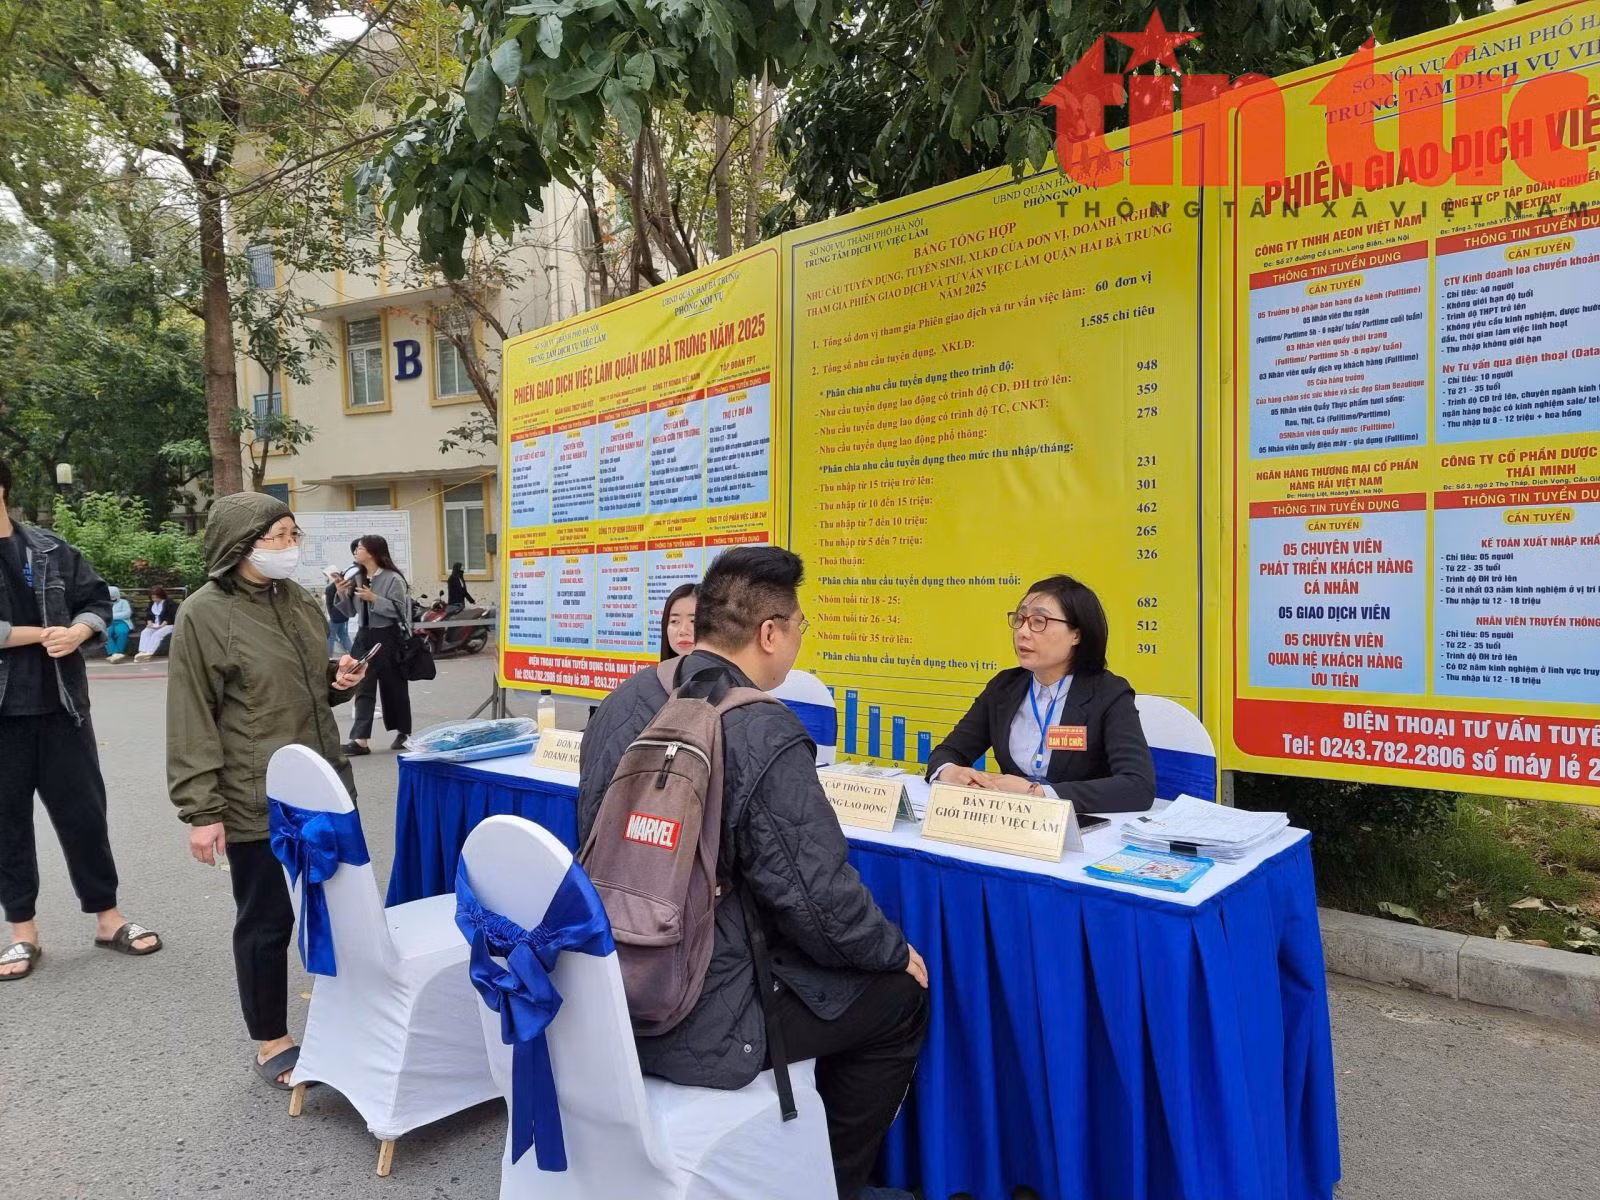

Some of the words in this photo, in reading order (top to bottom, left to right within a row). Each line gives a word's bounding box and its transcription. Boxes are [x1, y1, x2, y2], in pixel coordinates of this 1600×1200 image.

[1325, 92, 1399, 125] TRUNG
[1404, 78, 1452, 105] TÂM
[1459, 62, 1519, 92] DỊCH
[1525, 52, 1559, 75] VỤ
[1264, 160, 1353, 215] PHIÊN
[1365, 142, 1440, 192] GIAO
[1451, 120, 1534, 177] DỊCH
[914, 239, 946, 258] BẢNG
[950, 229, 985, 248] TỔNG
[989, 221, 1016, 238] HỢP
[1254, 242, 1283, 257] CÔNG
[1285, 239, 1298, 251] TY
[1302, 233, 1329, 248] TNHH
[1332, 226, 1363, 242] AEON
[1366, 220, 1391, 235] VIỆT
[1394, 214, 1422, 230] NAM
[1273, 268, 1308, 283] THÔNG
[1310, 264, 1328, 276] TIN
[1331, 256, 1366, 273] TUYỂN
[1369, 251, 1401, 266] DỤNG
[1095, 279, 1109, 292] 60
[1115, 274, 1137, 287] đơn
[1141, 269, 1152, 282] vị
[1309, 282, 1328, 295] CẦN
[1331, 277, 1361, 291] TUYỂN
[939, 287, 962, 300] NĂM
[965, 282, 986, 295] 2025
[1081, 312, 1109, 327] 1.585
[1113, 308, 1130, 322] chỉ
[1133, 305, 1155, 318] tiêu
[393, 339, 423, 381] B
[514, 380, 535, 405] PHIÊN
[537, 376, 554, 399] GIAO
[555, 370, 574, 397] DỊCH
[575, 362, 593, 390] VIỆC
[594, 357, 612, 383] LÀM
[614, 349, 639, 379] QUẬN
[641, 346, 655, 370] HAI
[658, 338, 671, 365] BÀ
[675, 331, 707, 360] TRƯNG
[709, 321, 735, 351] NĂM
[737, 314, 765, 343] 2025
[1136, 359, 1158, 372] 948
[1136, 382, 1158, 395] 359
[1136, 405, 1158, 419] 278
[1136, 455, 1158, 467] 231
[1256, 469, 1281, 481] NGÂN
[1283, 467, 1309, 479] HÀNG
[1311, 465, 1349, 477] THƯƠNG
[1351, 464, 1371, 475] MẠI
[1373, 460, 1387, 472] CỔ
[1390, 458, 1419, 471] PHẦN
[1136, 478, 1158, 490] 301
[1289, 480, 1315, 491] HÀNG
[1317, 478, 1334, 489] HẢI
[1336, 477, 1357, 489] VIỆT
[1359, 477, 1382, 487] NAM
[1136, 501, 1158, 514] 462
[1136, 525, 1158, 537] 265
[1136, 548, 1158, 560] 326
[1283, 543, 1298, 556] 05
[1301, 539, 1350, 555] CHUYÊN
[1353, 539, 1382, 554] VIÊN
[1445, 553, 1458, 561] Chỉ
[1491, 553, 1514, 561] người
[1260, 560, 1290, 576] PHÁT
[1293, 559, 1326, 575] TRIỂN
[1330, 559, 1373, 575] KHÁCH
[1377, 559, 1414, 574] HÀNG
[843, 576, 859, 585] chia
[861, 576, 877, 585] nhu
[879, 576, 893, 585] cầu
[895, 576, 919, 586] tuyển
[921, 576, 944, 586] dụng
[946, 576, 965, 584] theo
[968, 576, 995, 584] nhóm
[1304, 579, 1320, 594] CÁ
[1324, 579, 1359, 594] NHÂN
[818, 595, 841, 603] Nhóm
[843, 595, 857, 604] tuổi
[859, 596, 869, 604] từ
[871, 596, 880, 604] 18
[888, 596, 901, 604] 25:
[1137, 596, 1158, 609] 682
[1460, 597, 1480, 606] nhập
[1521, 598, 1541, 606] triệu
[1279, 607, 1293, 619] 05
[1296, 607, 1324, 619] GIAO
[1328, 607, 1357, 622] DỊCH
[1361, 605, 1391, 620] VIÊN
[1137, 620, 1158, 632] 512
[1284, 633, 1299, 645] 05
[1302, 632, 1351, 647] CHUYÊN
[1354, 633, 1384, 648] VIÊN
[1137, 643, 1158, 655] 391
[1268, 653, 1299, 666] QUAN
[1302, 652, 1318, 669] HỆ
[1322, 653, 1364, 668] KHÁCH
[1367, 654, 1403, 669] HÀNG
[556, 674, 562, 683] số
[562, 675, 574, 686] máy
[580, 677, 589, 686] 200
[1311, 674, 1328, 686] ƯU
[1331, 673, 1359, 687] TIÊN
[1343, 709, 1389, 735] ĐIỆN
[1395, 715, 1454, 740] THOẠI
[1461, 719, 1490, 738] TƯ
[1495, 716, 1541, 742] VẤN
[1049, 737, 1060, 746] BAN
[1061, 734, 1068, 746] TỔ
[1068, 735, 1084, 746] CHỨC
[543, 750, 568, 762] DOANH
[1283, 734, 1314, 756] Tel:
[1320, 737, 1465, 769] 0243.782.2806
[1472, 749, 1497, 772] số
[1504, 755, 1552, 781] máy
[1559, 758, 1581, 779] lẻ
[842, 783, 870, 794] THÔNG
[872, 787, 886, 796] TIN
[845, 800, 861, 810] LAO
[863, 802, 888, 814] ĐỘNG
[990, 800, 1005, 811] TƯ
[1007, 800, 1032, 814] VẤN
[935, 807, 961, 820] GIỚI
[963, 811, 997, 826] THIỆU
[1001, 816, 1029, 830] VIỆC
[1032, 820, 1059, 833] LÀM
[627, 814, 677, 848] MARVEL
